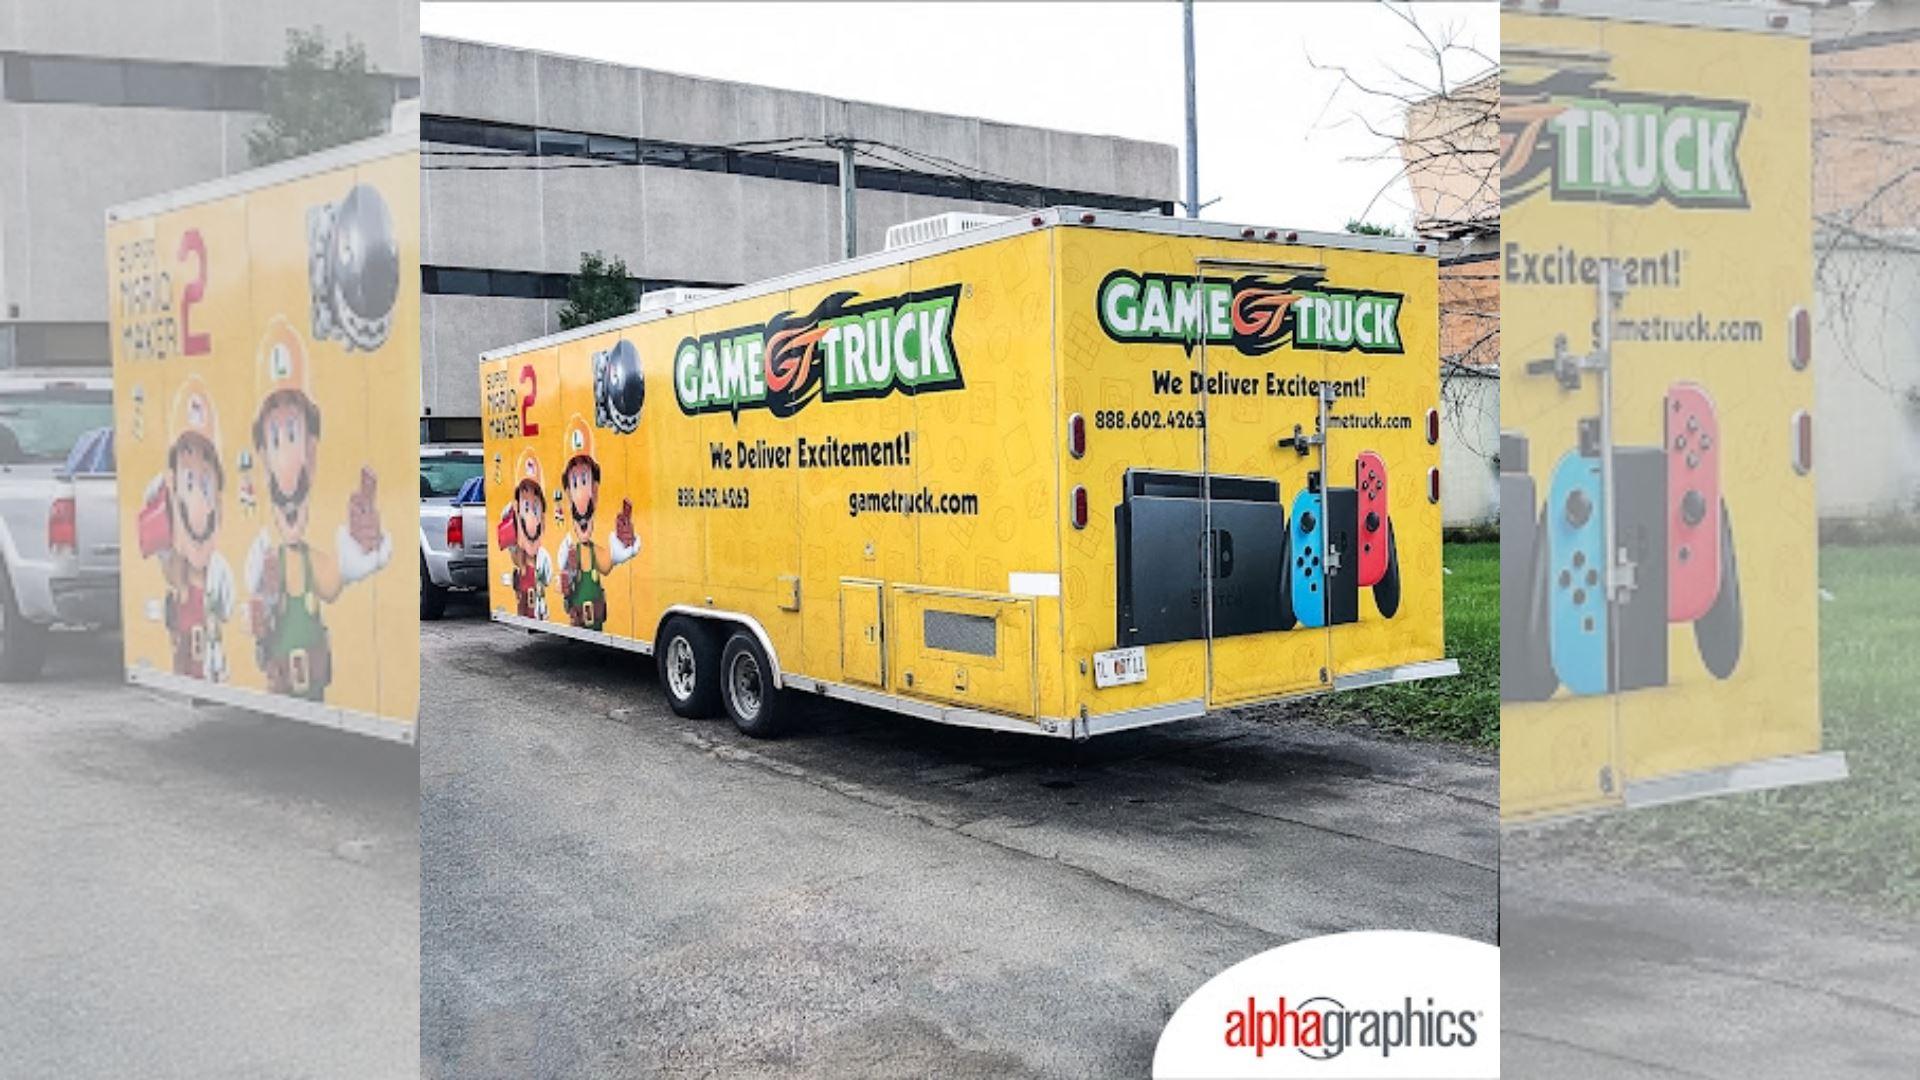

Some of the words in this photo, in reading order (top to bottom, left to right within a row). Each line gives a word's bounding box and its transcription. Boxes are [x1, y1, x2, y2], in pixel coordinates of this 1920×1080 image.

[1553, 108, 1734, 191] TRUCK
[179, 229, 210, 355] 2
[1104, 282, 1232, 337] GAME
[1293, 295, 1397, 344] TRUCK
[1592, 312, 1763, 348] gmetruck.com
[676, 337, 767, 406] GAME
[820, 306, 953, 388] TRUCK
[520, 365, 538, 436] 2
[1152, 370, 1183, 395] We
[1190, 370, 1259, 395] Deliver
[1095, 410, 1206, 429] 888.602.4263
[1315, 411, 1412, 432] gmetruck.com
[710, 441, 732, 470] We
[737, 438, 791, 469] Deliver
[798, 431, 911, 469] Excitement!
[849, 486, 978, 517] gametruck.com
